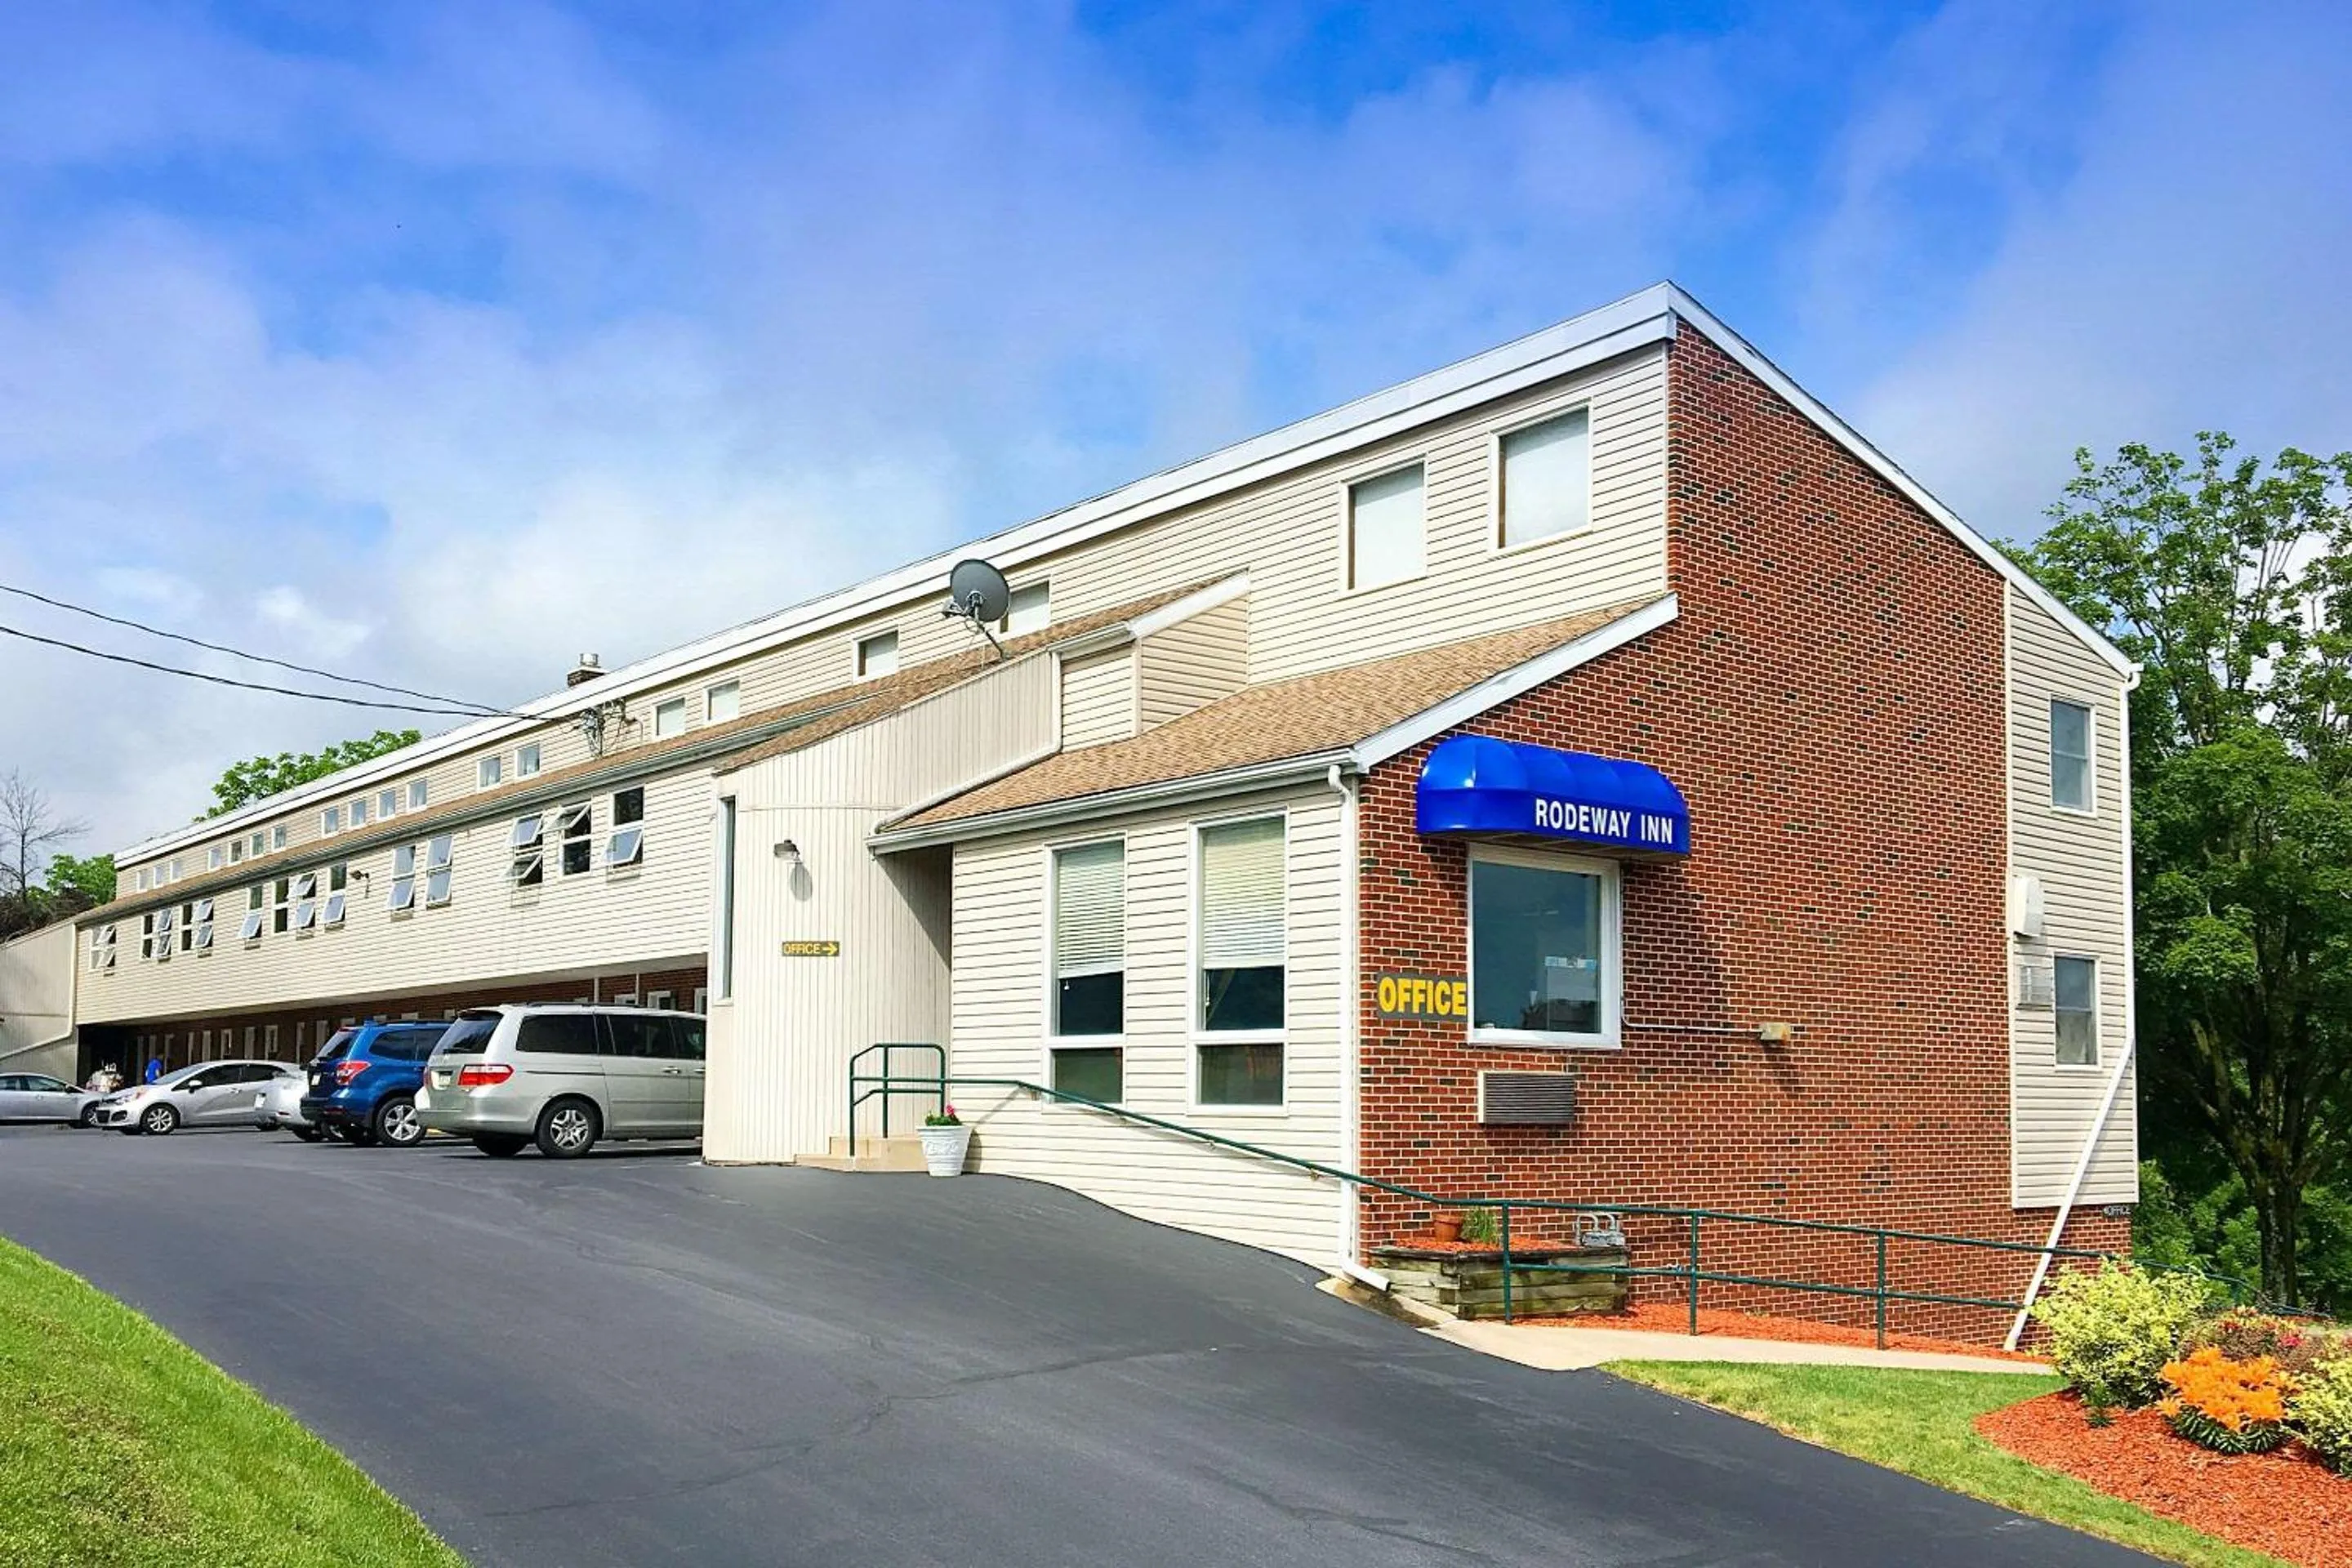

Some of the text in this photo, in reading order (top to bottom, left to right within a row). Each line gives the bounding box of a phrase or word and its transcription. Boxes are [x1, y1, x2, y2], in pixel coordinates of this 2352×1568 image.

[1535, 798, 1673, 844] RODEWAY INN
[783, 942, 822, 955] OFFICE
[1379, 976, 1467, 1016] OFFICE
